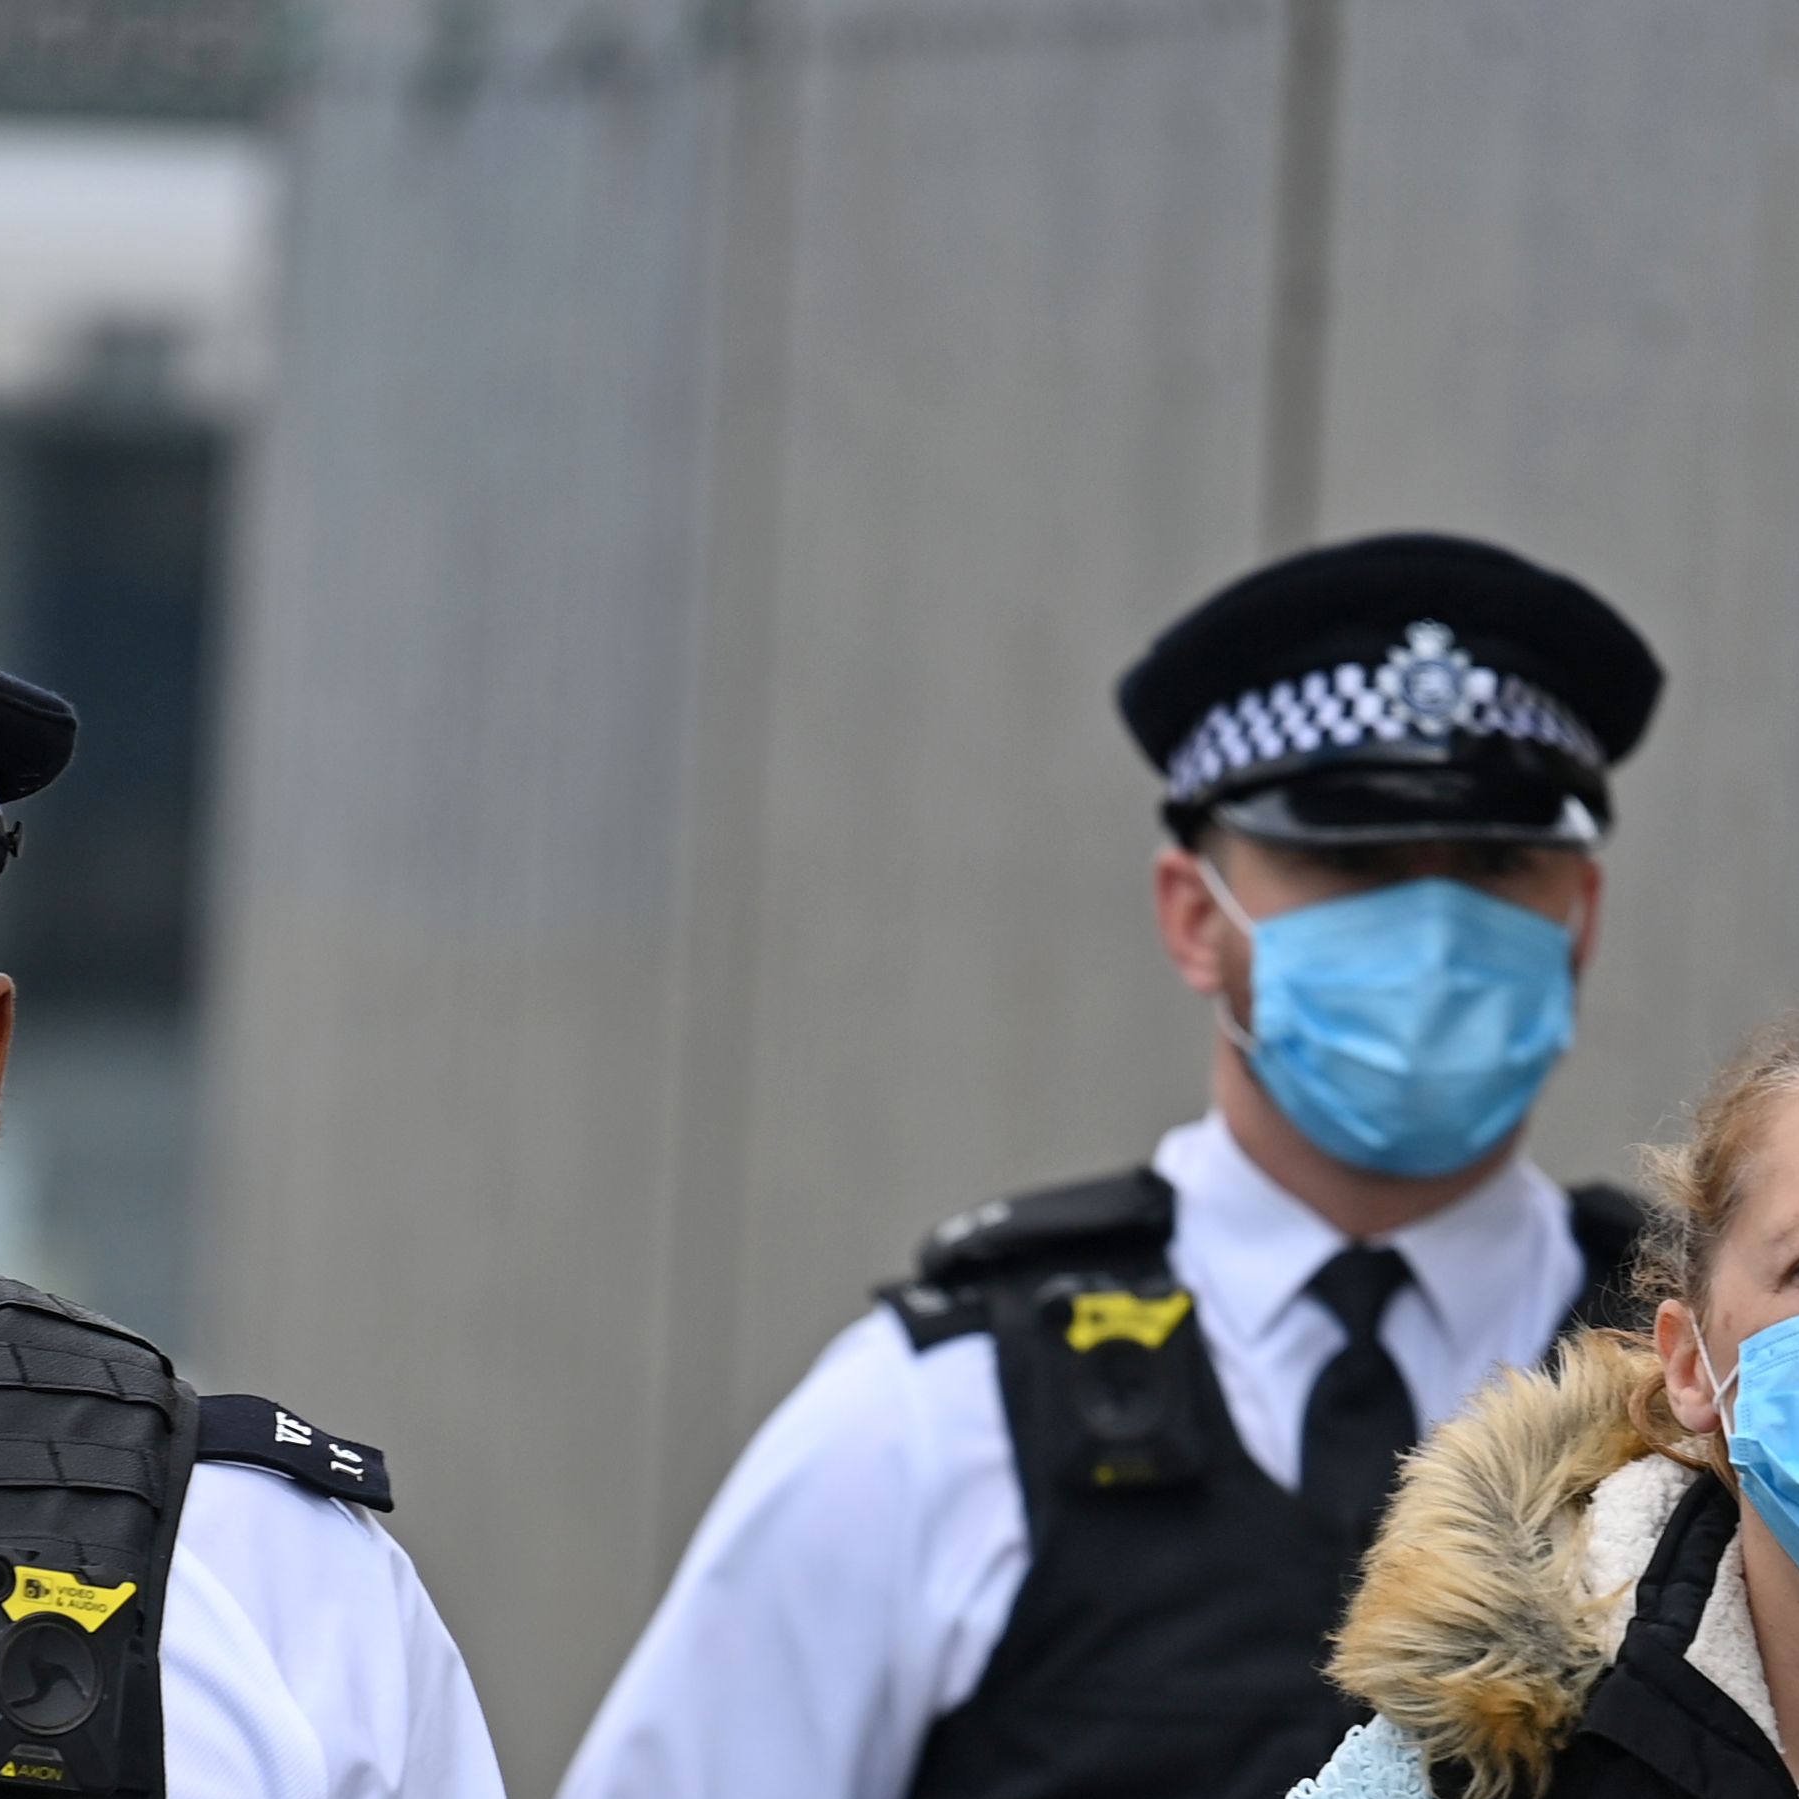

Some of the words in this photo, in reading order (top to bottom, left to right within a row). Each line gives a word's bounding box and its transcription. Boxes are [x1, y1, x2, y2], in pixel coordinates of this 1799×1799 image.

[56, 1586, 95, 1599] VIDEO
[67, 1599, 107, 1614] AUDIO
[17, 1764, 62, 1781] AXON
